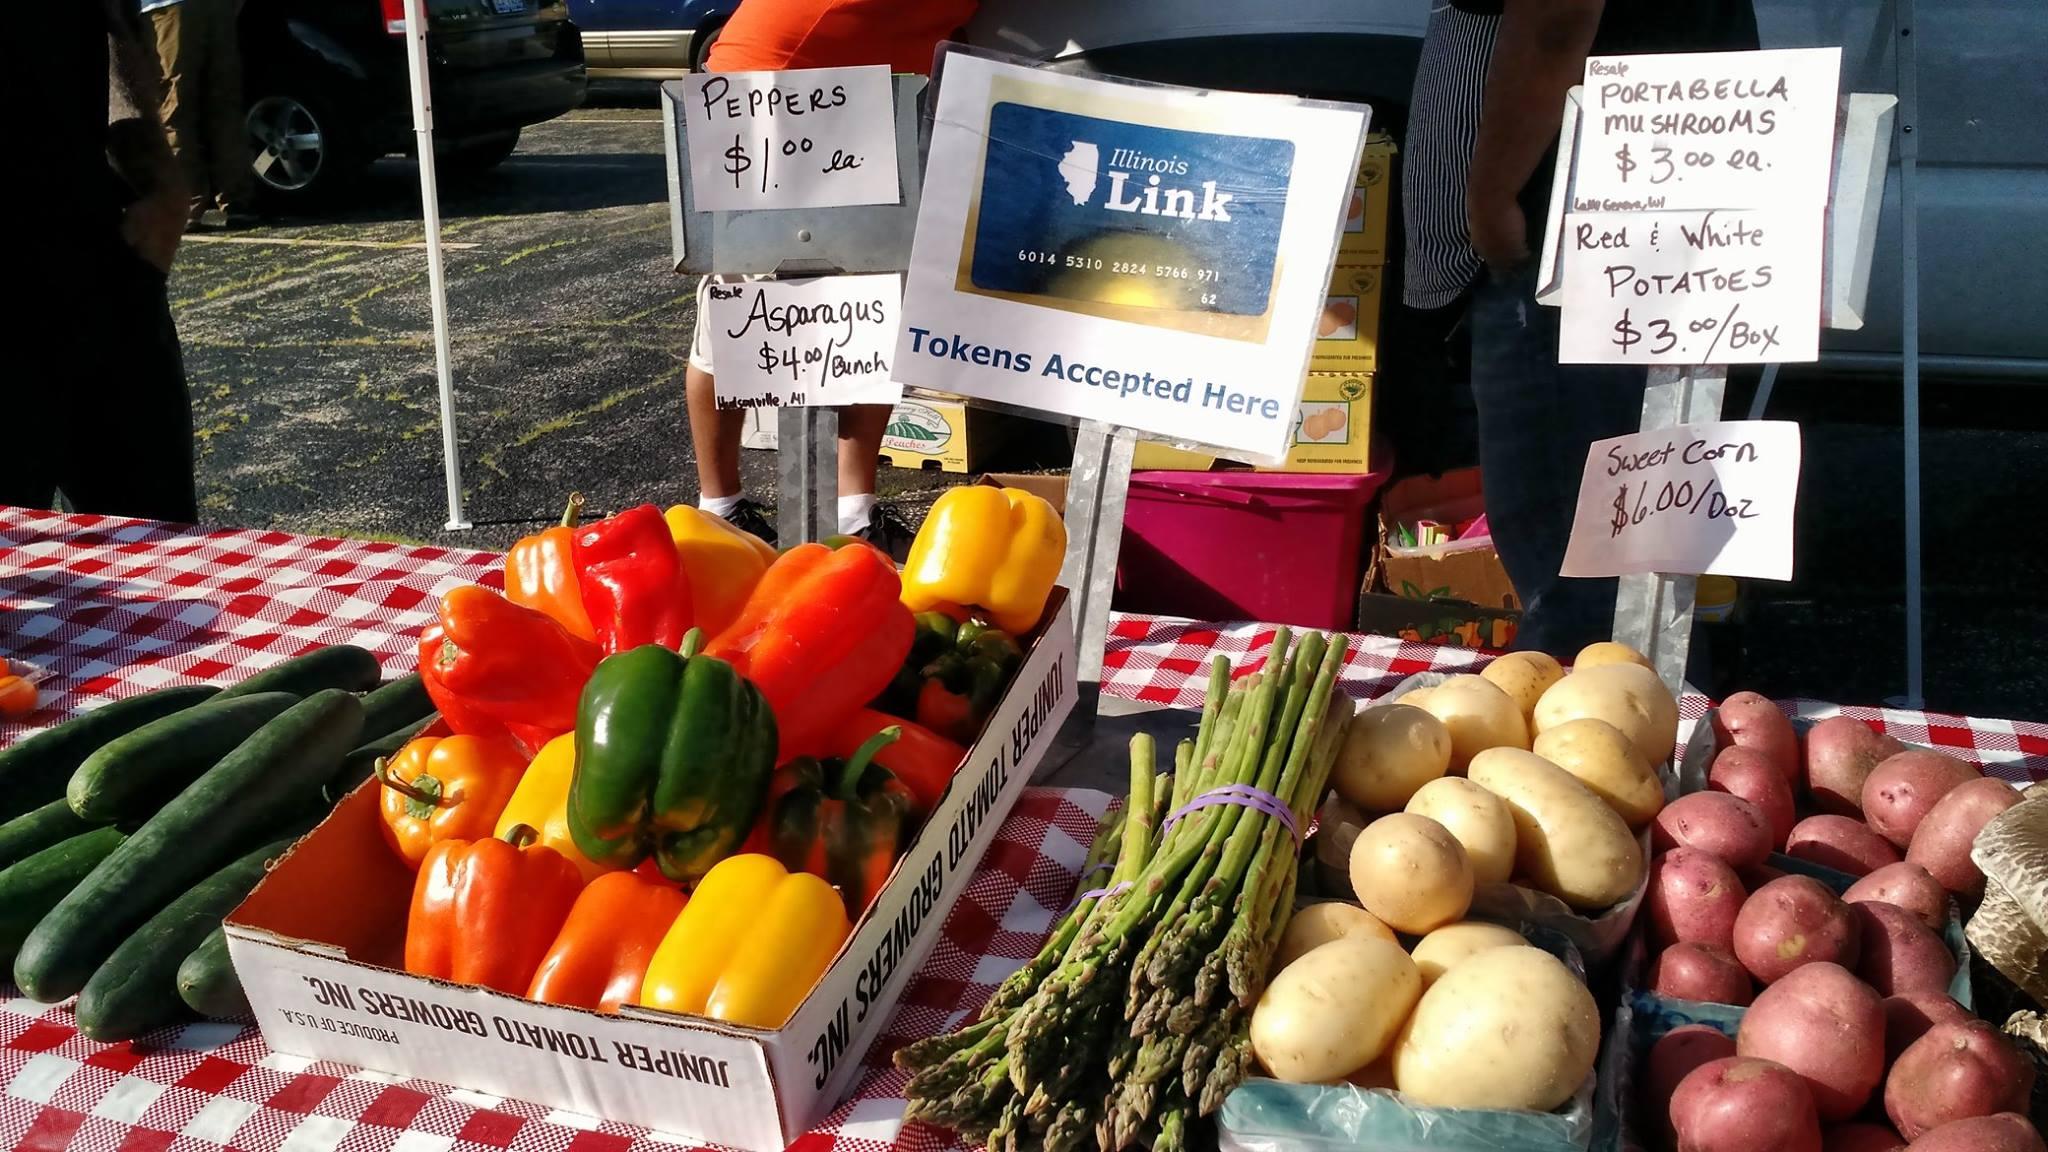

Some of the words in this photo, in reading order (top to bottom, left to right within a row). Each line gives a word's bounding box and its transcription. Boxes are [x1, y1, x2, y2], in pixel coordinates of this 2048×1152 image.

[1589, 60, 1628, 77] Resale
[701, 76, 848, 121] PEPPERS
[1601, 76, 1788, 109] PORTABELLA
[1604, 109, 1776, 136] MUSHROOMS
[1108, 148, 1189, 176] Illinois
[1103, 170, 1234, 222] Link
[1577, 223, 1630, 250] Red
[1680, 210, 1764, 250] White
[1018, 249, 1056, 265] 6014
[1065, 255, 1103, 271] 5310
[1112, 261, 1147, 275] 2824
[1156, 265, 1189, 280] 5766
[1197, 270, 1220, 282] 971
[1603, 264, 1773, 298] POTATOES
[709, 285, 743, 300] Resale
[1201, 293, 1217, 305] 62
[727, 288, 885, 348] Asparagus
[908, 327, 1033, 373] Tokens
[1042, 354, 1193, 404] Accepted
[1201, 382, 1281, 420] Here
[1608, 441, 1675, 476] Sweet
[1682, 440, 1759, 465] Corn
[1010, 650, 1064, 769] JUNIPER
[948, 742, 1010, 872] TOMATO
[856, 850, 944, 1021] GROWERS
[301, 976, 363, 1006] INC.
[277, 1006, 319, 1028] U.S.A.
[320, 1017, 337, 1033] OF
[358, 987, 486, 1037] GROWERS
[337, 1020, 401, 1045] PRODUCE
[493, 1014, 611, 1061] TOMATO
[806, 1008, 851, 1091] INC.
[615, 1039, 732, 1088] JUNIPER
